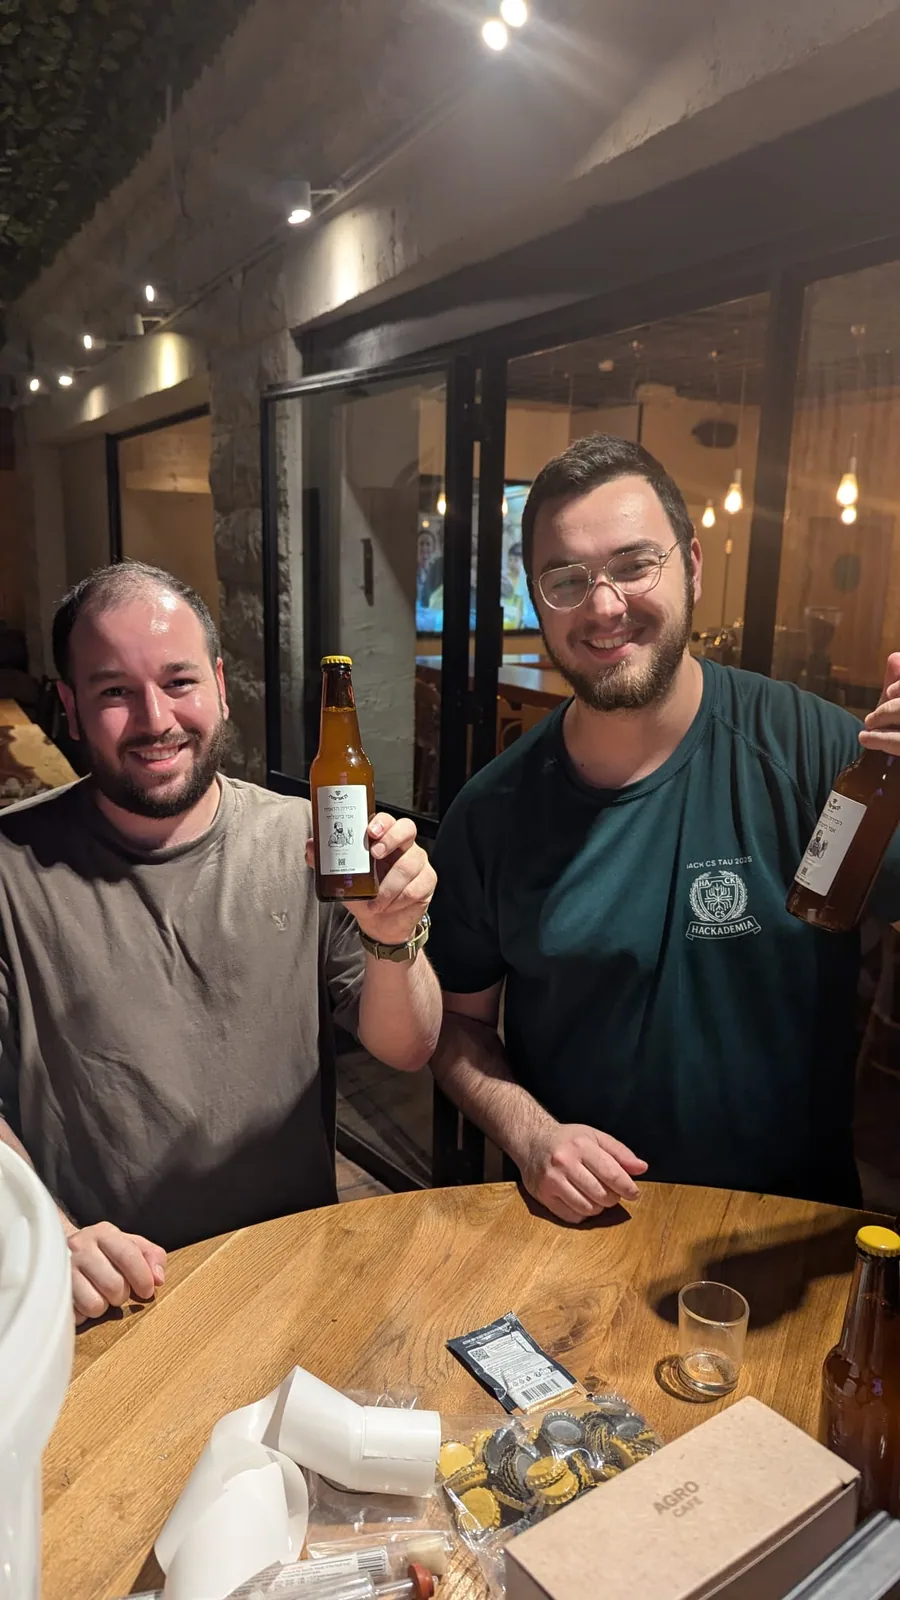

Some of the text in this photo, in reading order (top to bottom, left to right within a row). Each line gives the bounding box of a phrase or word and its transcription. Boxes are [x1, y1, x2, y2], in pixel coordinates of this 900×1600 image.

[705, 859, 717, 868] CS
[717, 857, 734, 866] TAU
[698, 876, 737, 887] HA CK
[714, 910, 726, 918] CS
[691, 920, 755, 936] HACKADEMIA
[653, 1481, 700, 1515] AGRO
